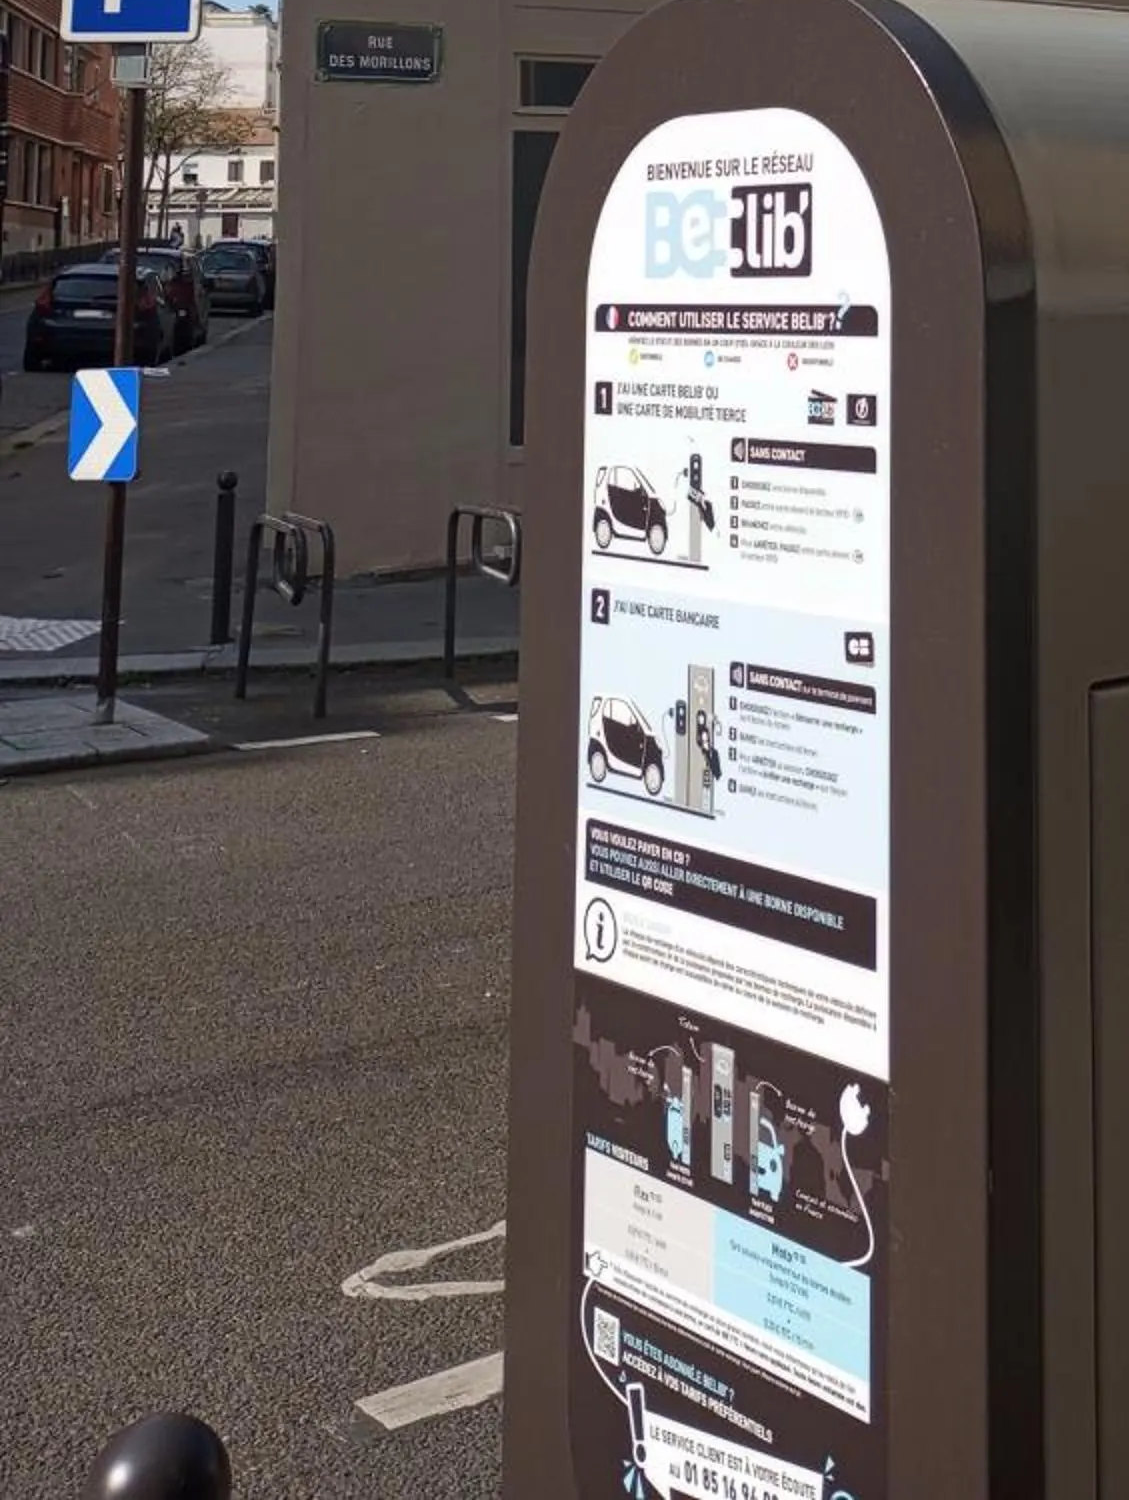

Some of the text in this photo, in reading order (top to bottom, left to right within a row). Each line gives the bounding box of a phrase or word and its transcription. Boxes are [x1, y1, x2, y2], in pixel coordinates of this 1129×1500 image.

[367, 35, 394, 49] RUE
[329, 54, 355, 69] DES
[359, 55, 432, 70] MORILLONS
[646, 151, 813, 181] BIENVENUE SUR LE RÉSEAU
[627, 311, 677, 328] COMMENT
[679, 311, 724, 329] UTILISER
[726, 312, 740, 329] LE
[741, 312, 788, 330] SERVICE
[617, 382, 630, 395] J'AI
[632, 382, 648, 396] UNE
[650, 383, 675, 398] CARTE
[706, 386, 718, 400] OU
[617, 402, 746, 423] UNE CARTE DE MOBILITÉ TIERCE
[750, 446, 806, 461] SANS CONTACT
[629, 601, 645, 617] UNE
[647, 605, 673, 622] CARTE
[675, 609, 720, 629] BANCAIRE
[749, 671, 768, 686] SANS
[769, 675, 803, 693] CONTACT
[591, 828, 608, 843] VOUS
[610, 832, 637, 851] VOULEZ
[637, 839, 660, 858] PAYER
[590, 859, 673, 896] ET UTILISER LE QR CODE
[591, 844, 608, 858] VOUS
[610, 848, 637, 867] POUVEZ
[685, 870, 738, 899] DIRECTEMENT
[738, 884, 745, 900] À
[746, 888, 763, 906] UNE
[764, 893, 793, 915] BORNE
[623, 1331, 642, 1354] VOUS
[643, 1340, 663, 1362] ÊTES
[664, 1375, 679, 1392] VOS
[681, 1382, 708, 1407] TARIFS
[708, 1396, 773, 1444] PRÉFÉRENTIELS
[649, 1422, 660, 1440] LE
[662, 1429, 694, 1454] SERVICE
[696, 1440, 726, 1465] CLIENT
[728, 1453, 743, 1473] EST
[744, 1455, 751, 1476] À
[752, 1463, 780, 1487] VOTRE
[781, 1470, 816, 1500] ÉCOUTE
[669, 1463, 681, 1479] AU
[684, 1460, 698, 1485] 01
[703, 1466, 719, 1495] 85
[722, 1475, 737, 1500] 16
